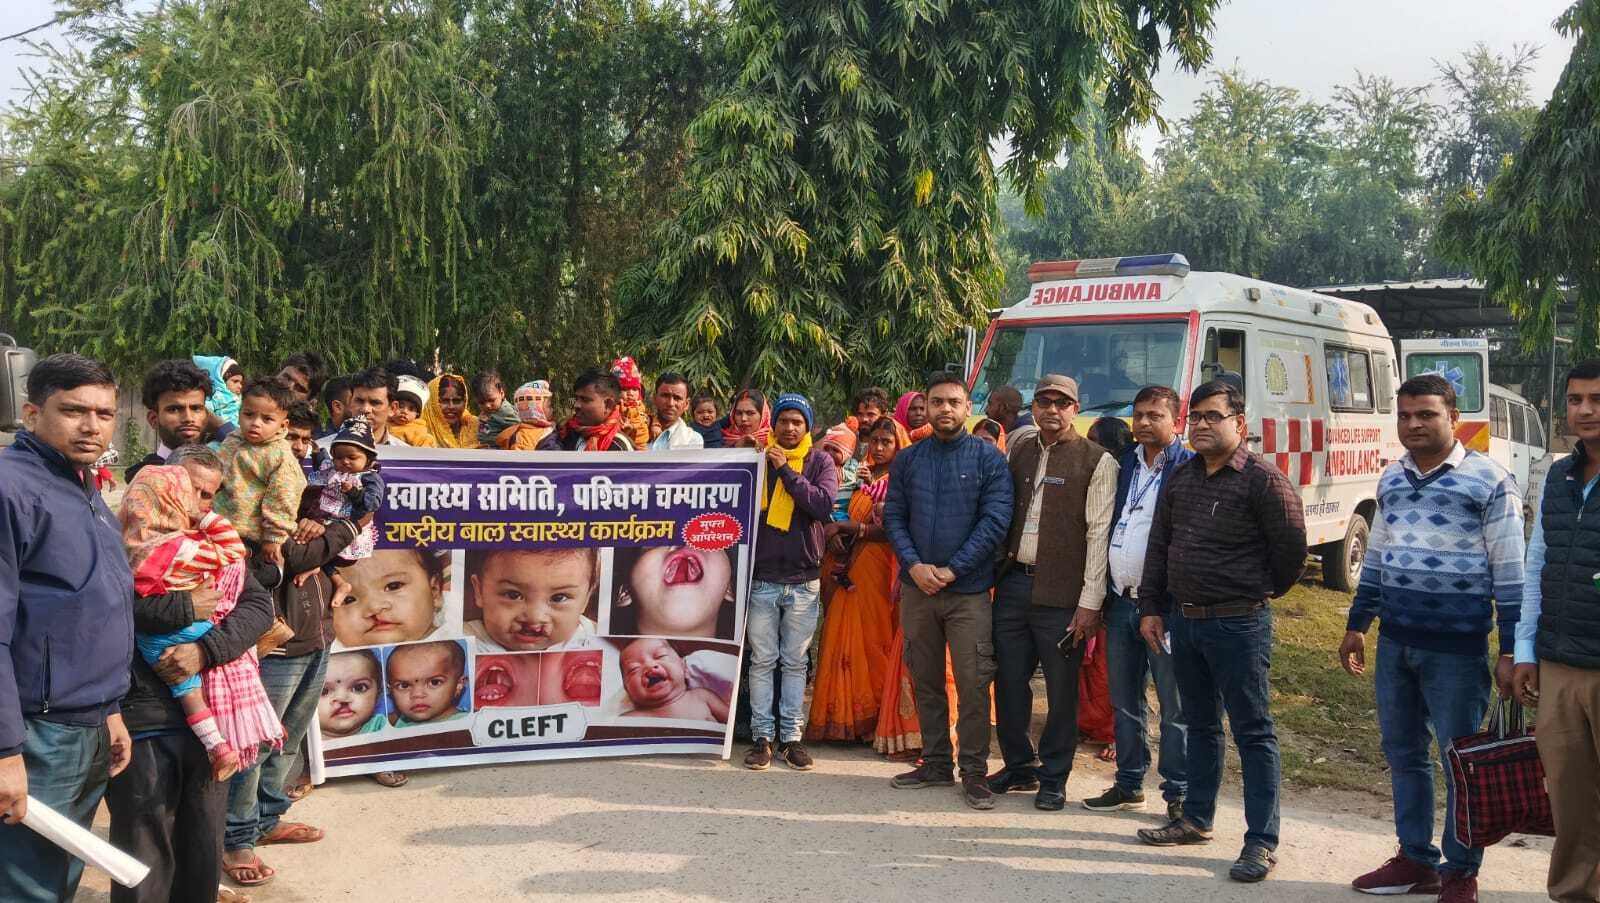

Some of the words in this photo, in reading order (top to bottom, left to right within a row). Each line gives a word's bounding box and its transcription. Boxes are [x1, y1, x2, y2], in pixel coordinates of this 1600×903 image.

[1326, 428, 1350, 444] ADVANCED
[1351, 428, 1360, 444] LIFE
[1361, 428, 1381, 443] SUPPORT
[1325, 449, 1380, 477] AMBULANCE
[386, 482, 473, 511] स्वास्थ्य
[477, 475, 566, 517] समिति,
[572, 475, 651, 510] पश्चिम
[655, 483, 742, 510] चम्पारण
[385, 515, 456, 547] राष्ट्रीय
[460, 522, 507, 542] बाल
[509, 520, 586, 543] स्वास्थ्य
[590, 514, 676, 543] कार्यक्रम
[699, 519, 726, 532] मुफ्त
[487, 713, 568, 739] CLEFT
